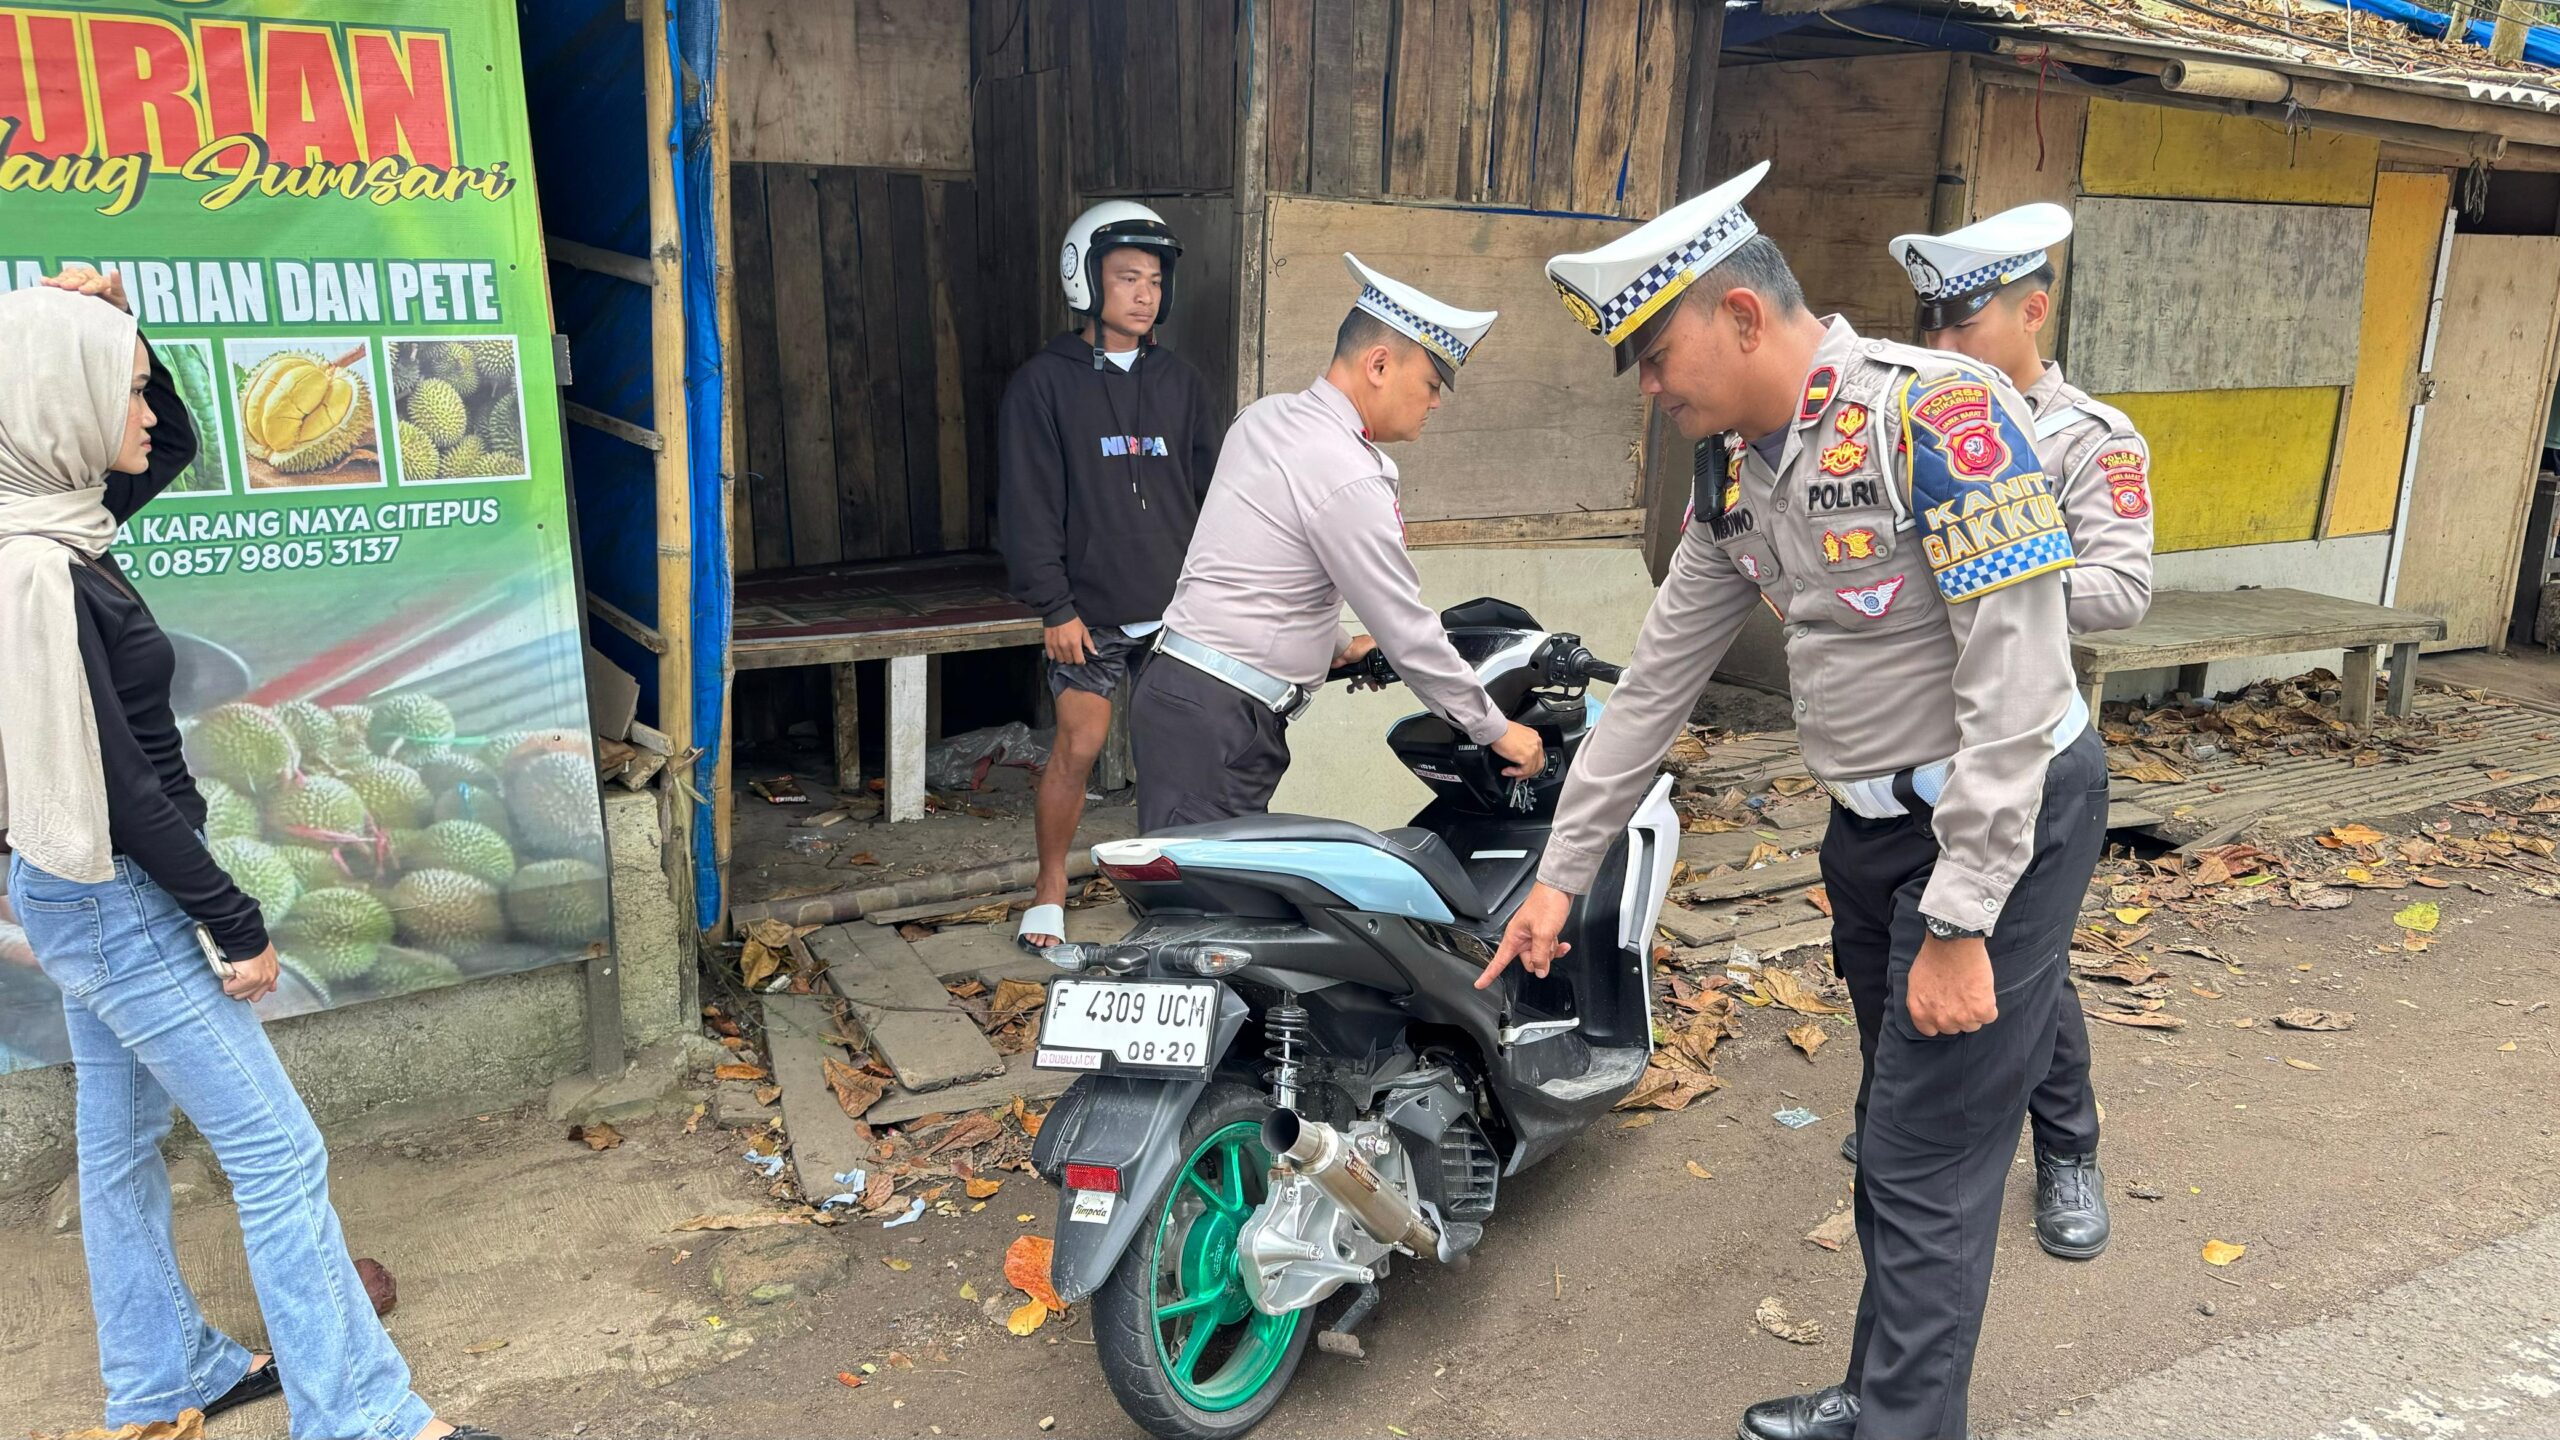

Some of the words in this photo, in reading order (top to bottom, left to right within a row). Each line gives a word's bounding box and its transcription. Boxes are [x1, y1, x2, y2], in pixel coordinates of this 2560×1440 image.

[181, 133, 513, 210] Jumsari
[62, 261, 268, 324] URIAN
[275, 262, 381, 322] DAN
[387, 262, 499, 321] PETE
[1921, 388, 1984, 416] POLRES
[1808, 480, 1879, 511] POLRI
[1925, 472, 2046, 531] KANIT
[143, 511, 280, 544] KARANG
[289, 504, 375, 535] NAYA
[377, 498, 499, 528] CITEPUS
[148, 547, 232, 575] 0857
[240, 541, 323, 571] 9805
[330, 536, 400, 565] 3137
[1053, 989, 1069, 1019] F
[1086, 991, 1146, 1023] 4309
[1158, 994, 1207, 1028] UCM
